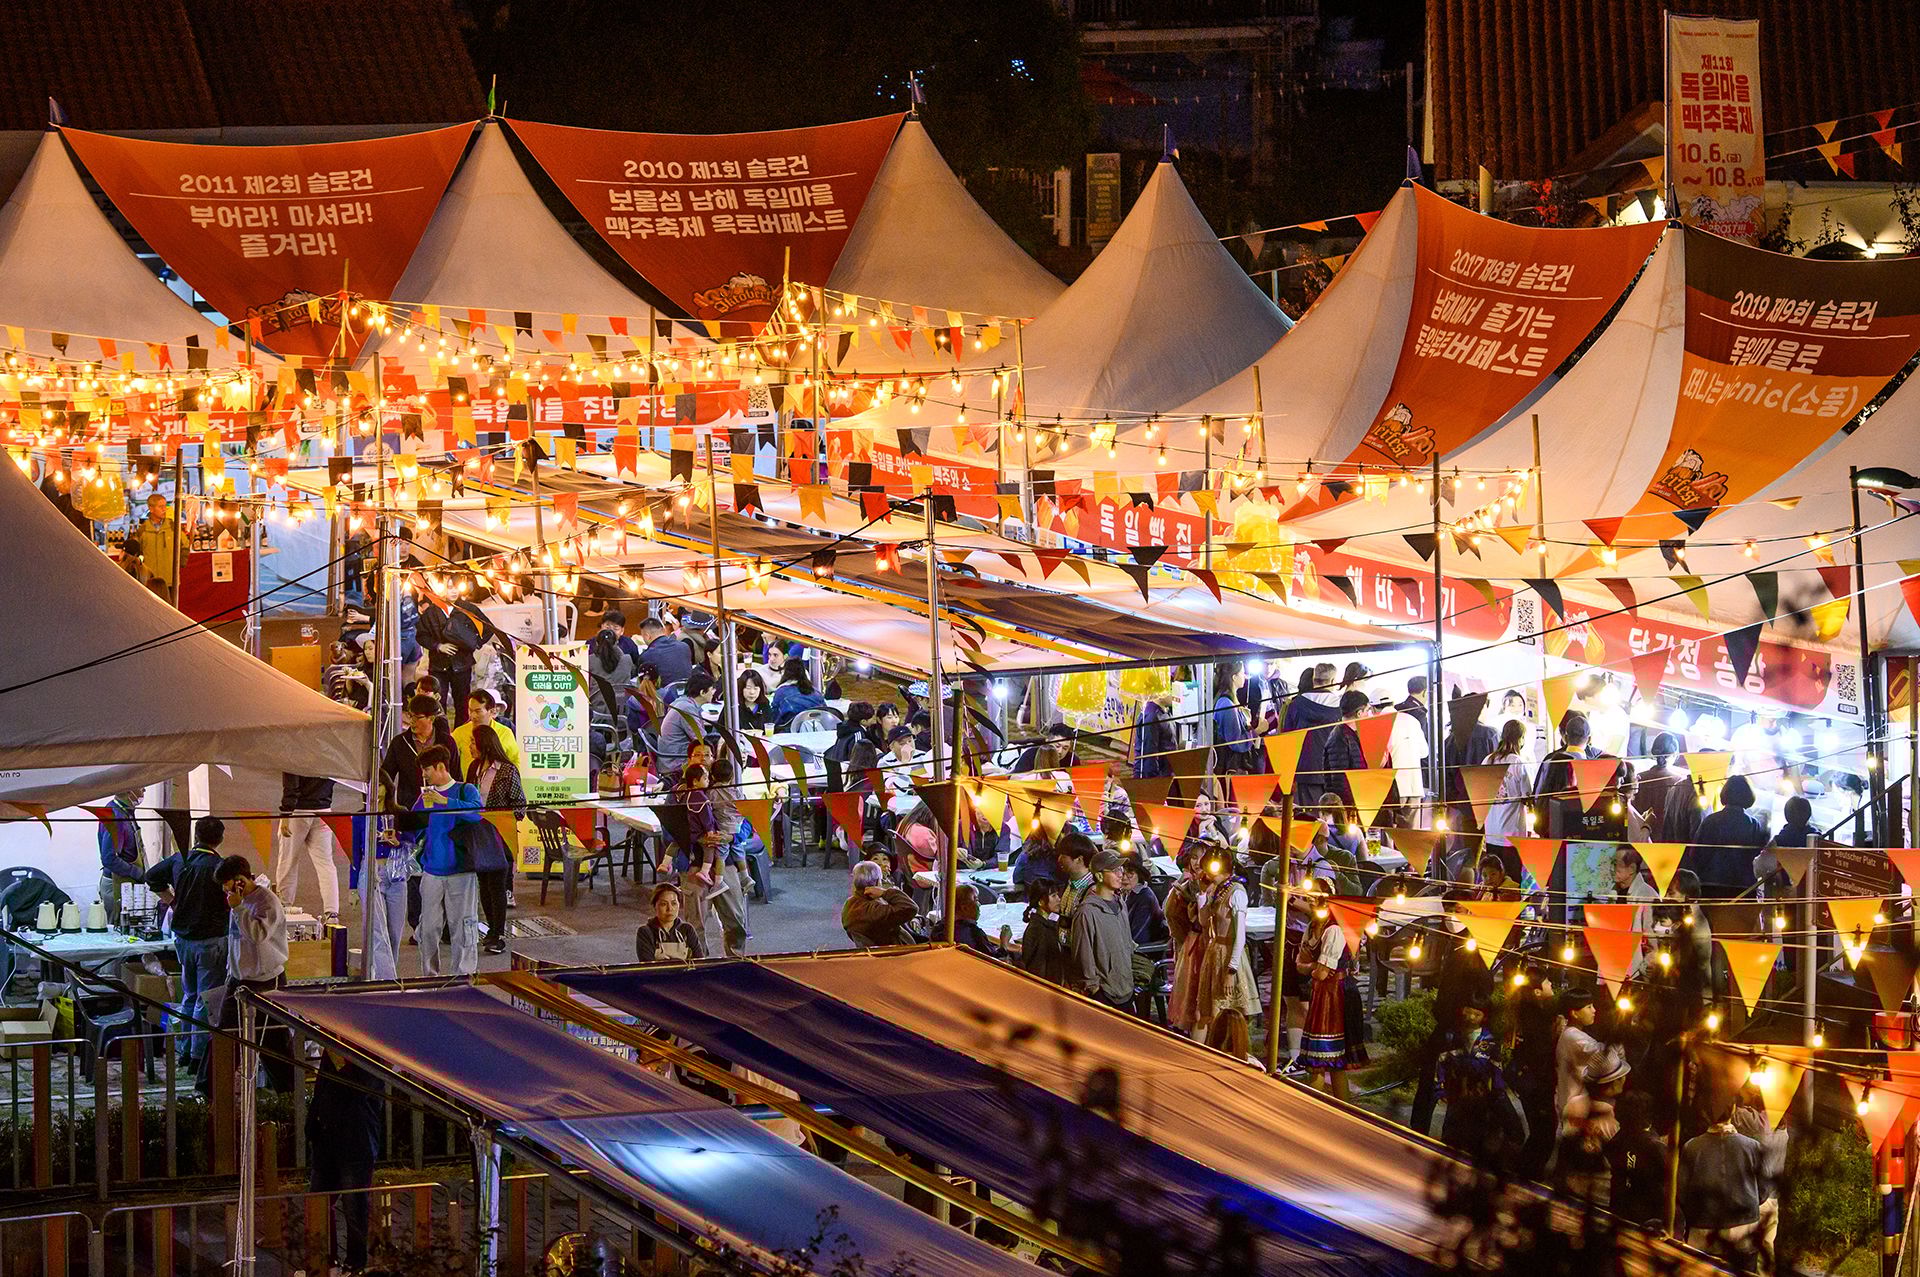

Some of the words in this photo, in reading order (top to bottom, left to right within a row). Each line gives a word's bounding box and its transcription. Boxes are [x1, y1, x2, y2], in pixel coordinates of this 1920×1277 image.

[1701, 54, 1734, 71] 제11회
[1681, 72, 1751, 103] 독일마을
[1681, 104, 1754, 134] 맥주축제
[624, 160, 683, 179] 2010
[689, 160, 742, 180] 제1회
[746, 154, 810, 178] 슬로건
[179, 174, 237, 194] 2011
[243, 174, 300, 195] 제2회
[306, 168, 374, 194] 슬로건
[608, 189, 683, 213] 보물섬
[688, 188, 739, 212] 남해
[743, 183, 835, 209] 독일마을
[190, 205, 278, 229] 부어라!
[288, 202, 373, 228] 마셔라!
[604, 215, 706, 240] 맥주축제
[711, 209, 848, 236] 옥토버페스트
[240, 232, 337, 258] 즐겨라!
[1449, 249, 1485, 278] 2017
[1516, 262, 1575, 292] 슬로건
[1481, 302, 1556, 340] 즐기는
[1730, 290, 1770, 320] 2019
[1766, 298, 1816, 326] 제9회
[1810, 300, 1878, 331] 슬로건
[532, 674, 551, 682] 쓰레기
[552, 674, 572, 682] ZERO
[554, 682, 571, 690] OUT!
[523, 736, 582, 752] 깔끔거리
[531, 753, 575, 769] 만들기
